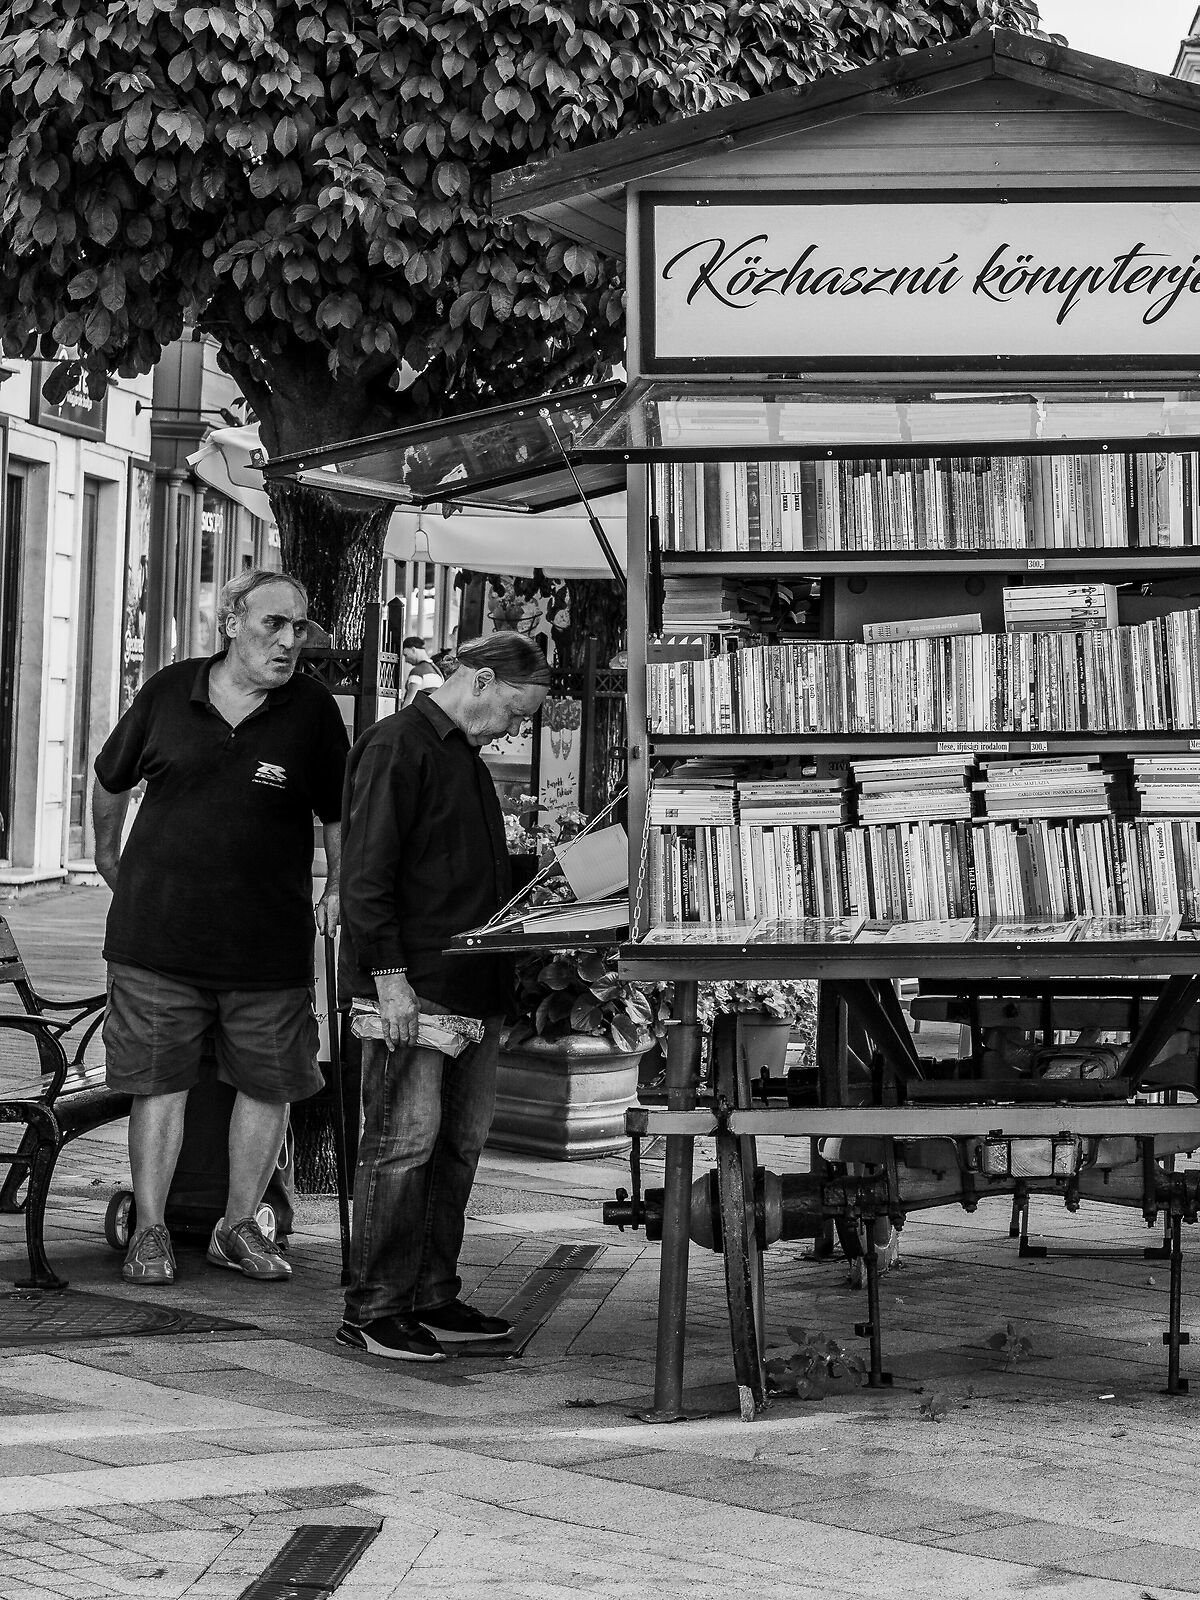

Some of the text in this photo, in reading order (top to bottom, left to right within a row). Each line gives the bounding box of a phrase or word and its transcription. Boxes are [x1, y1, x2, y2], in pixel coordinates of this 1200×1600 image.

[662, 233, 963, 310] Közhasznú
[980, 742, 1008, 751] irodalom
[968, 866, 976, 891] STEPH
